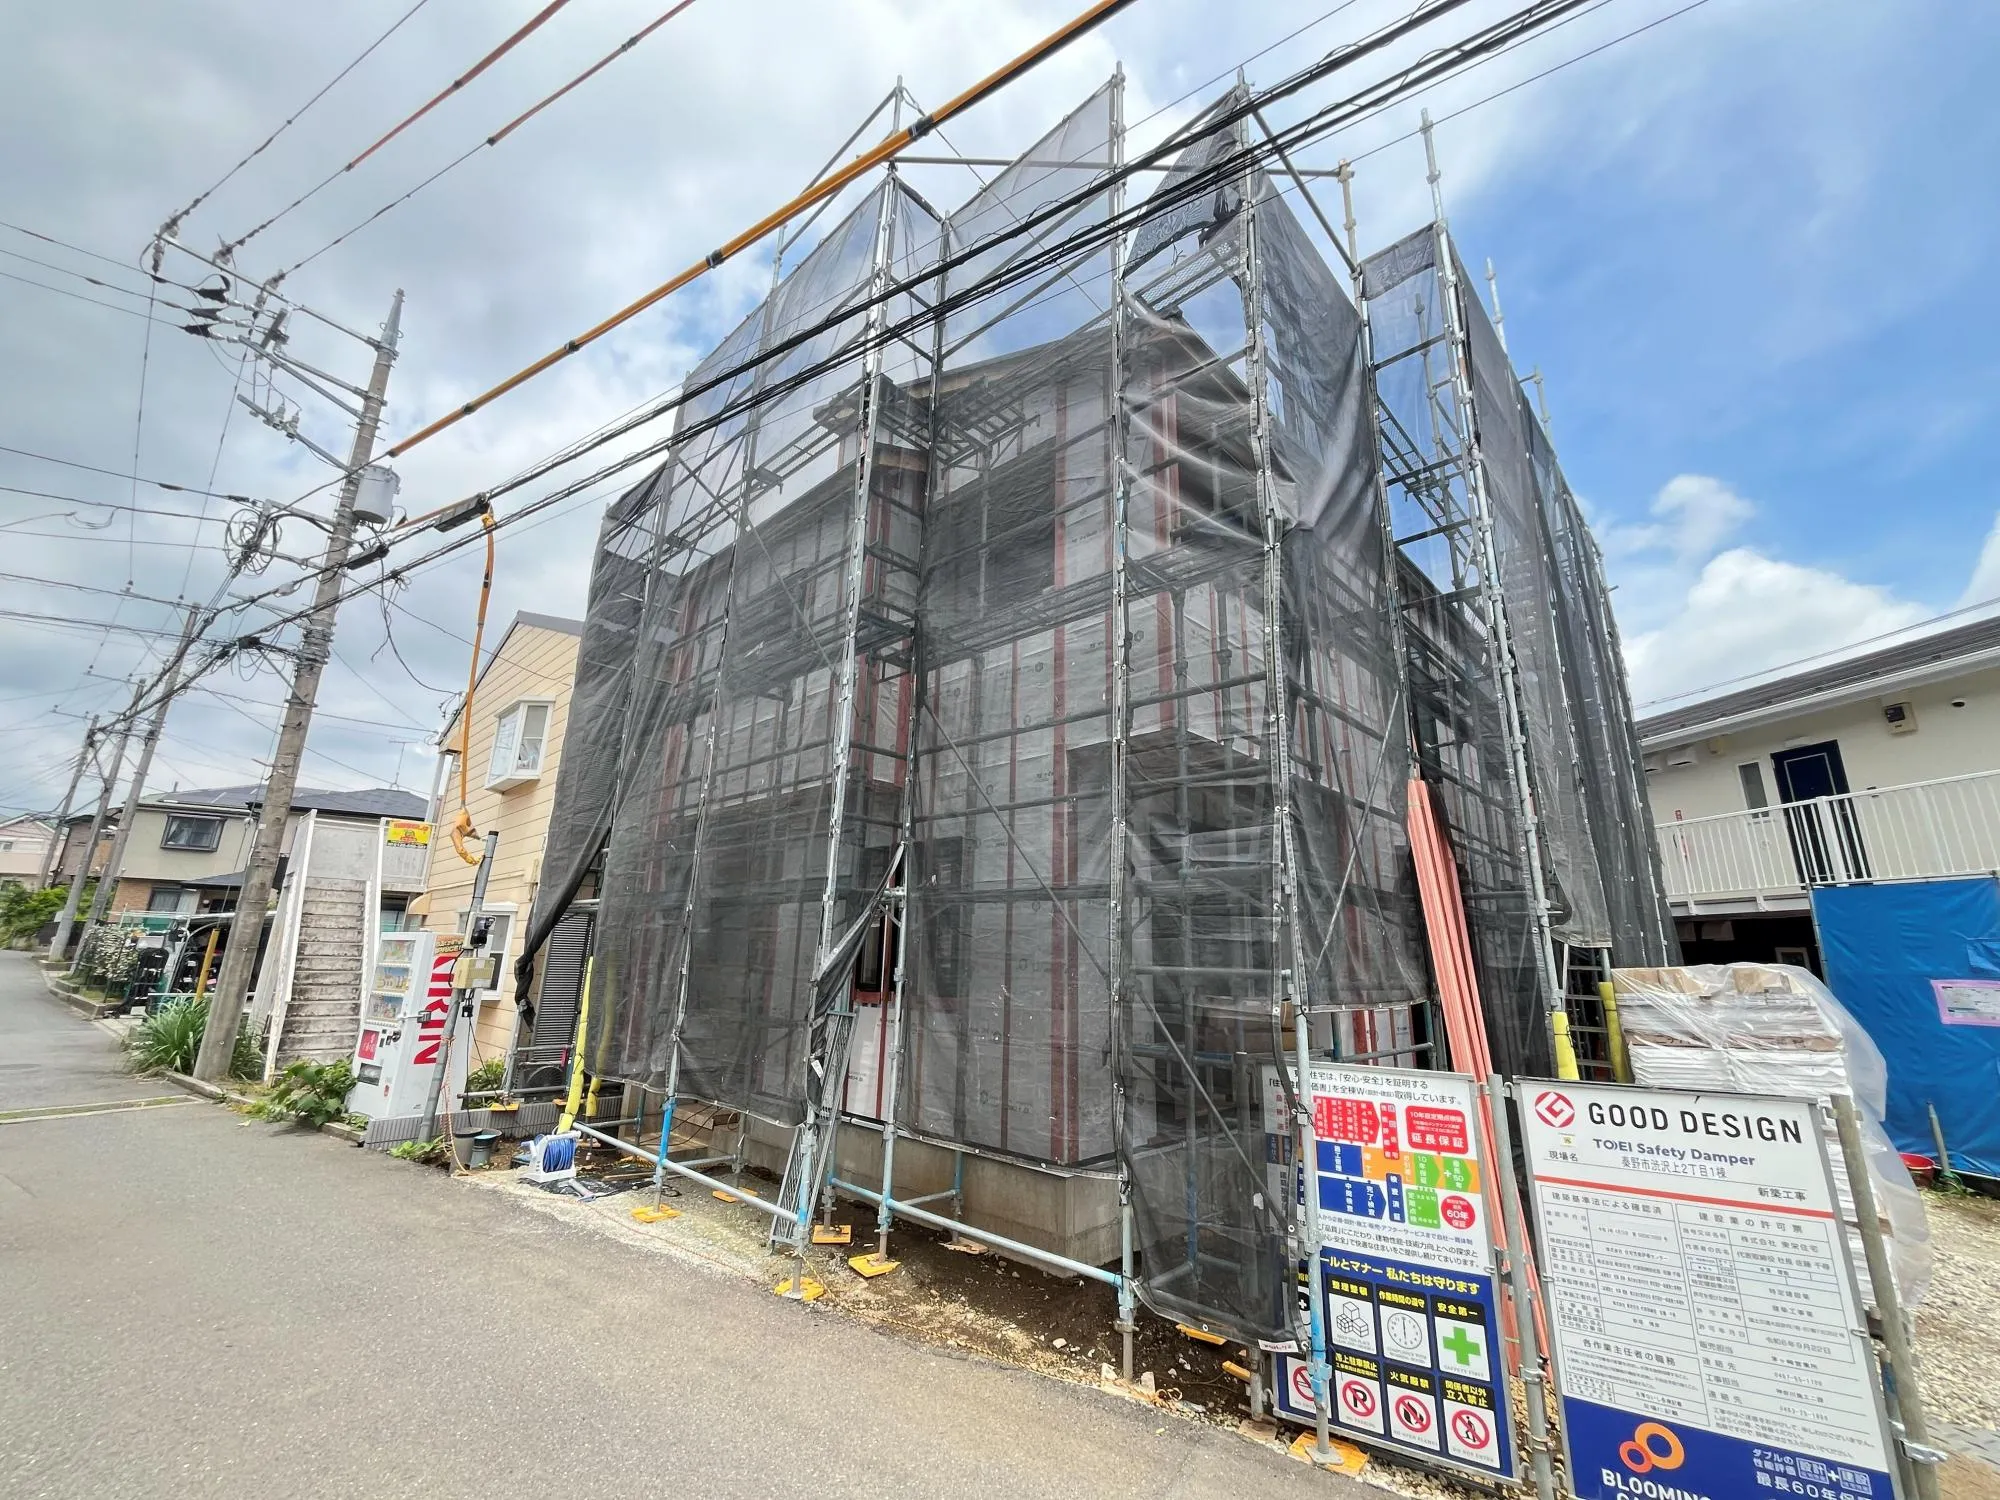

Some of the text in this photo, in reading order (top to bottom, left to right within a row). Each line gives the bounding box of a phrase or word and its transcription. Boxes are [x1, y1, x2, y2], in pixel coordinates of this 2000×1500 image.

[1588, 1102, 1803, 1144] GOOD DESIGN
[1411, 1132, 1464, 1148] 延長保証
[1548, 1150, 1578, 1162] 現場名
[1637, 1143, 1686, 1160] Safety
[1691, 1149, 1755, 1167] Damper
[1551, 1191, 1662, 1215] 建築基準法による確認済
[1757, 1187, 1807, 1201] 新築工事
[1446, 1209, 1469, 1219] 60年
[1698, 1211, 1804, 1234] 建設業の許可票
[1319, 1256, 1480, 1295] ールとマナー 私たちは守ります
[1437, 1302, 1478, 1317] 安全第一
[1582, 1338, 1676, 1366] 各作業主任者の職務
[1390, 1371, 1430, 1389] 火気厳禁
[1445, 1380, 1487, 1397] 関係者以外
[1446, 1389, 1489, 1408] 立入禁止
[1800, 1461, 1825, 1476] 設計
[1601, 1468, 1712, 1500] BLOOMI
